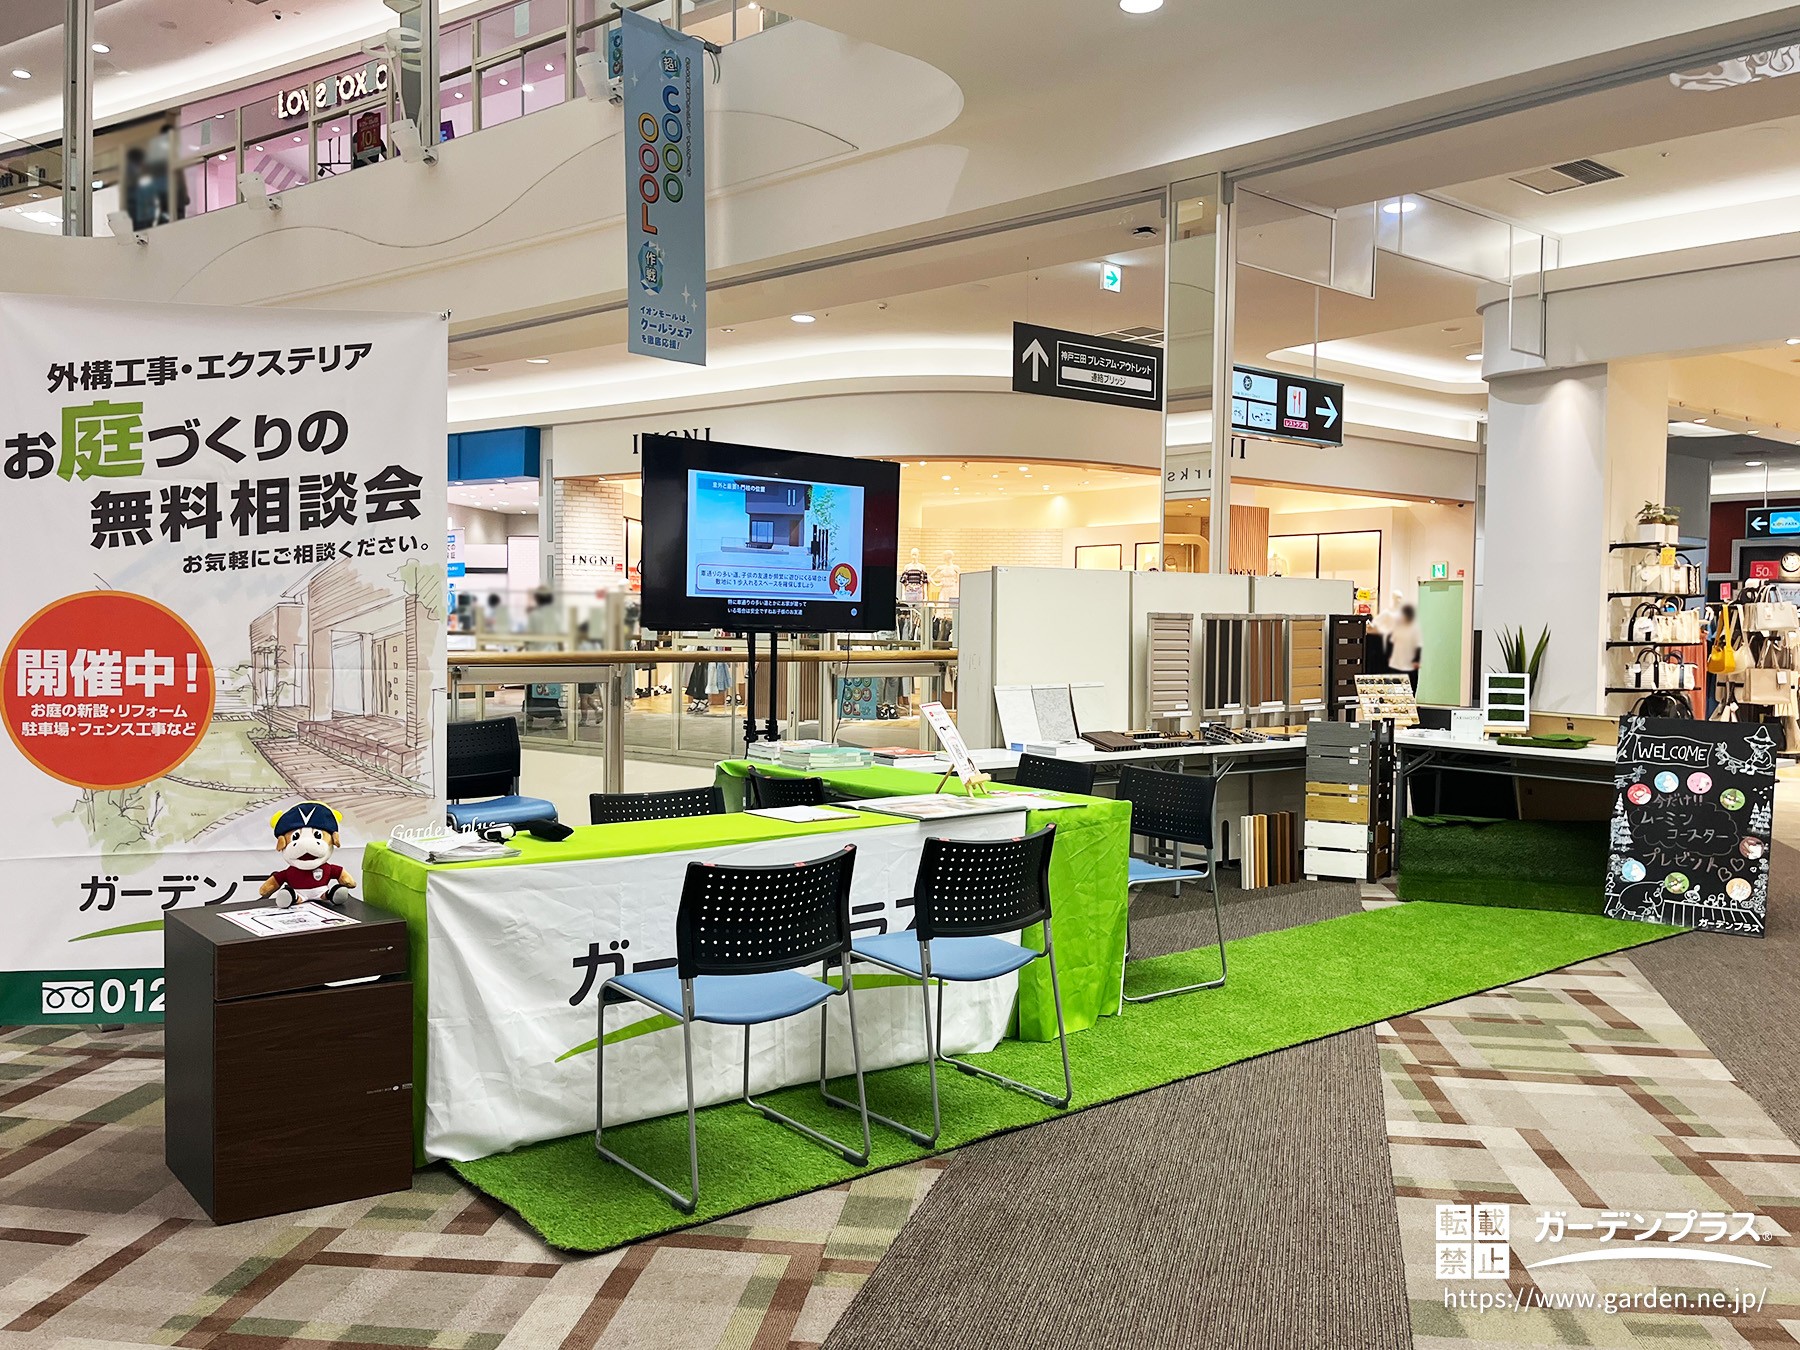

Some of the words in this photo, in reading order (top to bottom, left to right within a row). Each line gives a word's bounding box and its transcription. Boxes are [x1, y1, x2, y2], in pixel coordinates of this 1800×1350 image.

[645, 251, 657, 283] 作戦
[640, 318, 693, 339] クールシェア
[46, 342, 374, 393] 外構工事・エクステリア
[1060, 350, 1088, 365] 神戸三田
[1087, 355, 1153, 375] プレミアム・アウトレット
[3, 399, 350, 483] お庭づくりの
[90, 464, 424, 550] 無料相談会
[181, 534, 430, 574] お気軽にご相談ください。
[571, 555, 615, 566] INGNI
[16, 648, 198, 698] 開催中!
[30, 702, 189, 719] お庭の新設・リフォーム
[21, 721, 197, 738] 駐車場・フェンス工事など
[1638, 742, 1708, 761] WELCOME
[1641, 811, 1694, 826] ムーミン
[1667, 829, 1729, 843] コースター
[1643, 847, 1719, 873] プレゼント
[79, 876, 274, 912] ガーデン
[1698, 918, 1760, 933] ガーデンプラス
